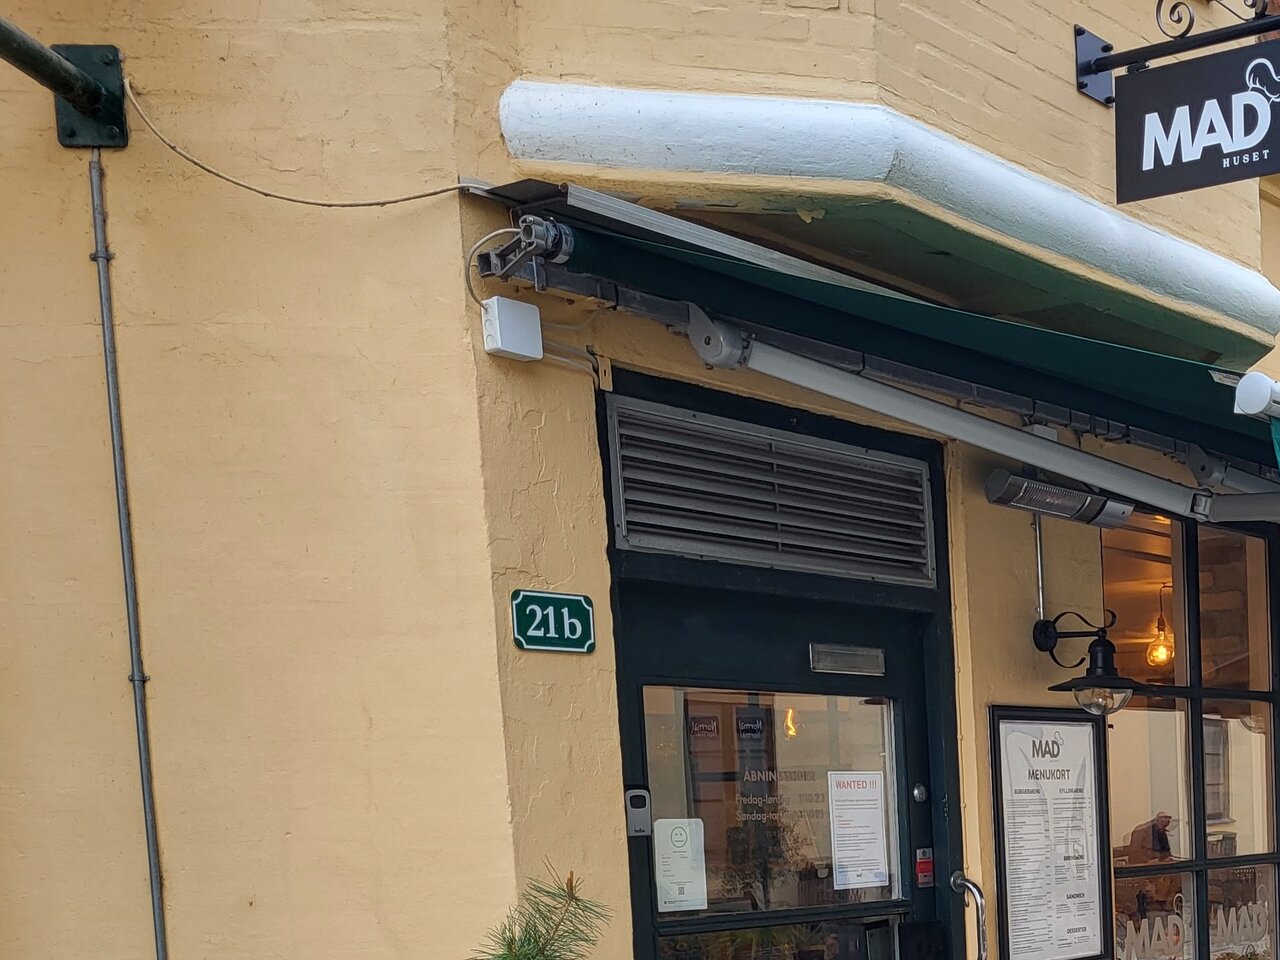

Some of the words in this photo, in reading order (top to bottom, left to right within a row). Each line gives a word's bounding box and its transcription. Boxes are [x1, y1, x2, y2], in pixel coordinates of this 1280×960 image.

[1142, 91, 1271, 171] MAD
[1222, 149, 1270, 168] HUSET
[525, 604, 583, 639] 21b
[1031, 739, 1061, 759] MAD
[1027, 768, 1071, 781] MENUKORT
[835, 780, 868, 790] WANTED
[1217, 902, 1268, 946] MAD
